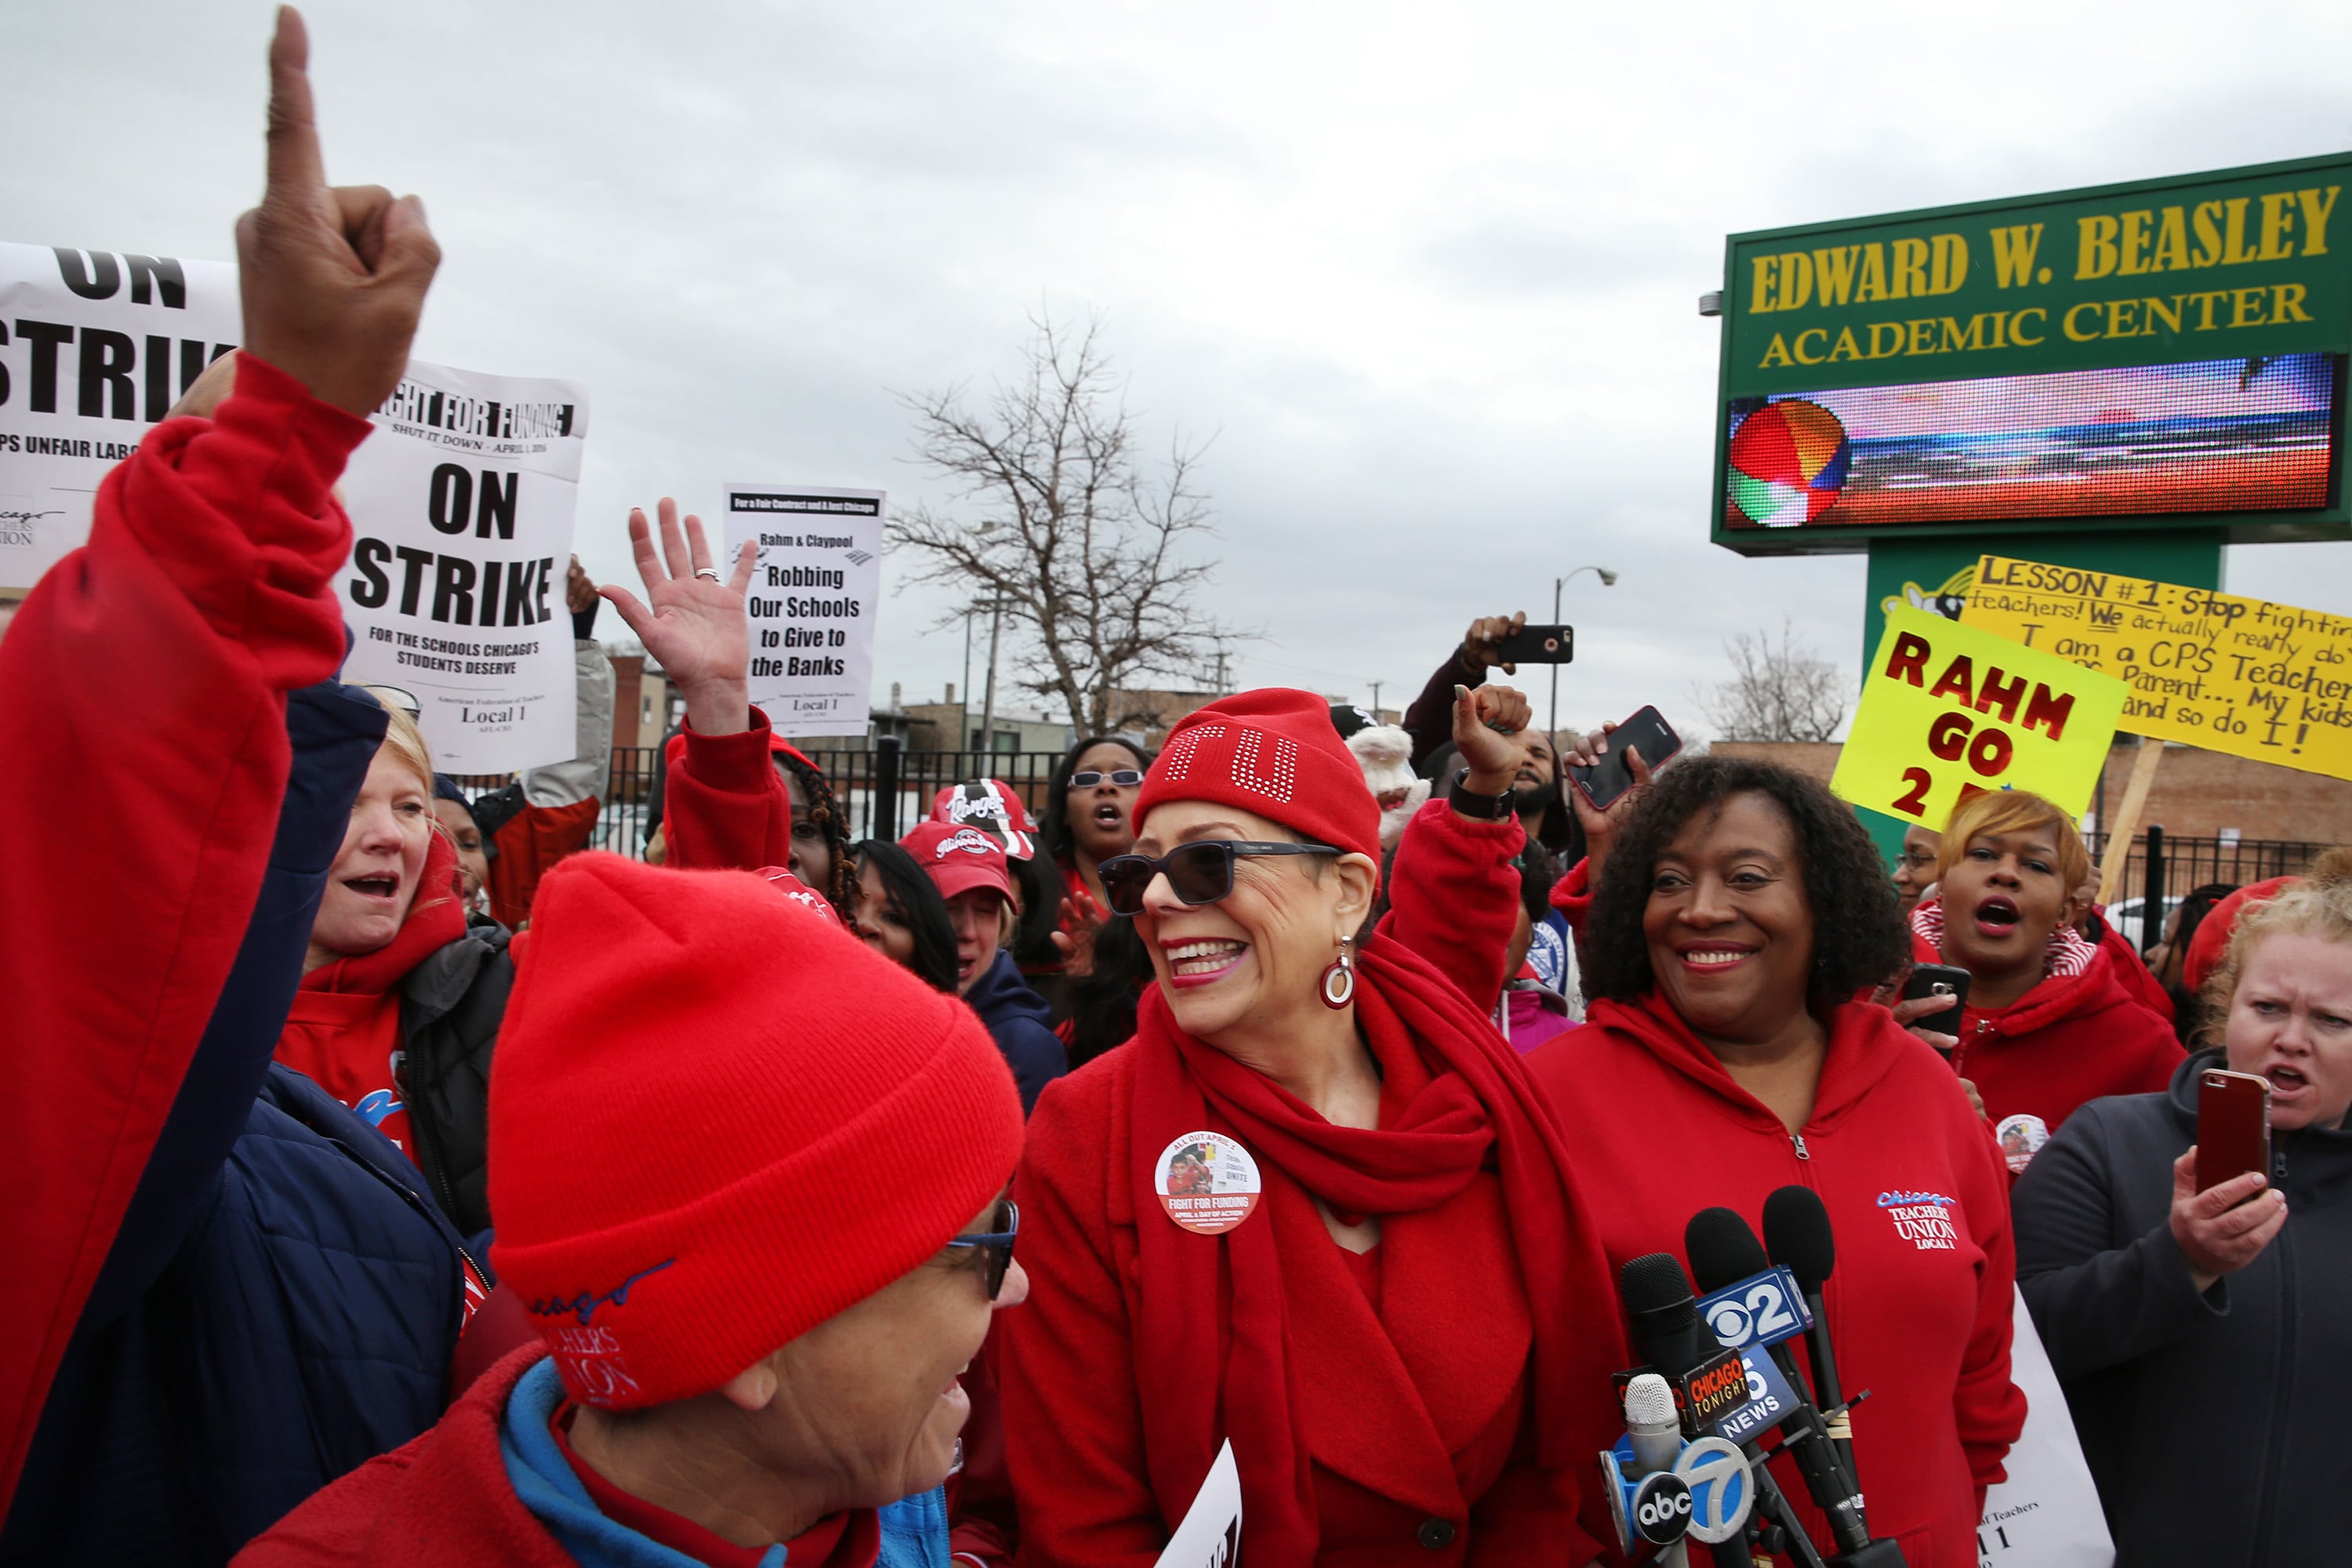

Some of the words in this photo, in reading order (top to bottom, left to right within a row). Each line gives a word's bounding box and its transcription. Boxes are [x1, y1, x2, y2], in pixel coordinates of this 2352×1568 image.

[1748, 232, 1970, 315] EDWARD
[1990, 223, 2053, 289] W.
[2074, 185, 2342, 281] BEASLEY
[1757, 308, 2047, 369] ACADEMIC
[2063, 282, 2314, 343] CENTER
[440, 392, 491, 439] FOR
[497, 402, 564, 441] FUNDING
[26, 436, 91, 458] UNFAIR
[392, 424, 425, 437] SHUT
[426, 430, 441, 444] IT
[442, 434, 484, 451] DOWN
[492, 444, 524, 454] APRIL
[428, 462, 520, 540] ON
[735, 497, 748, 509] For
[756, 498, 772, 510] Fair
[772, 499, 807, 510] Contract
[760, 533, 793, 546] Rahm
[796, 536, 804, 547] &
[806, 535, 853, 549] Claypool
[350, 536, 554, 628] STRIKE
[768, 565, 844, 590] Robbing
[750, 597, 782, 618] Our
[786, 597, 860, 618] Schools
[1980, 557, 2109, 599] LESSON
[2182, 588, 2248, 630] Stop
[369, 626, 392, 643] FOR
[396, 631, 419, 648] THE
[421, 637, 481, 657] SCHOOLS
[483, 641, 539, 657] CHICAGO'S
[760, 629, 780, 648] to
[784, 627, 823, 648] Give
[827, 629, 846, 648] to
[1968, 590, 2085, 620] teachers!
[2089, 601, 2123, 626] We
[2131, 611, 2223, 648] actually
[2234, 627, 2303, 665] really
[397, 651, 463, 673] STUDENTS
[465, 661, 517, 675] DESERVE
[750, 656, 782, 677] the
[786, 656, 845, 677] Banks
[2055, 637, 2100, 659] am
[2117, 645, 2135, 662] a
[2148, 641, 2217, 674] CPS
[1884, 630, 2076, 741] RAHM
[2123, 664, 2234, 705] Parent...
[2248, 688, 2290, 720] My
[461, 706, 513, 724] Local
[793, 699, 829, 711] Local
[2122, 695, 2169, 720] and
[2176, 706, 2204, 726] so
[2213, 707, 2248, 735] do
[1928, 711, 2013, 777] GO
[1892, 766, 1933, 818] 2
[1174, 1138, 1189, 1151] ALL
[1189, 1134, 1204, 1142] OUT
[1168, 1197, 1193, 1210] FIGHT
[1194, 1197, 1211, 1210] FOR
[1211, 1196, 1249, 1209] FUNDING
[1876, 1189, 1956, 1207] Chicago
[1887, 1205, 1951, 1221] TEACHERS
[1893, 1218, 1958, 1240] UNION
[1914, 1239, 1950, 1250] LOCAL
[1745, 1283, 1795, 1336] 2
[1690, 1358, 1743, 1403] CHICAGO
[1693, 1377, 1747, 1417] TONIGHT
[1722, 1396, 1780, 1439] NEWS
[1639, 1492, 1693, 1526] abc
[1991, 1501, 2040, 1523] Teachers
